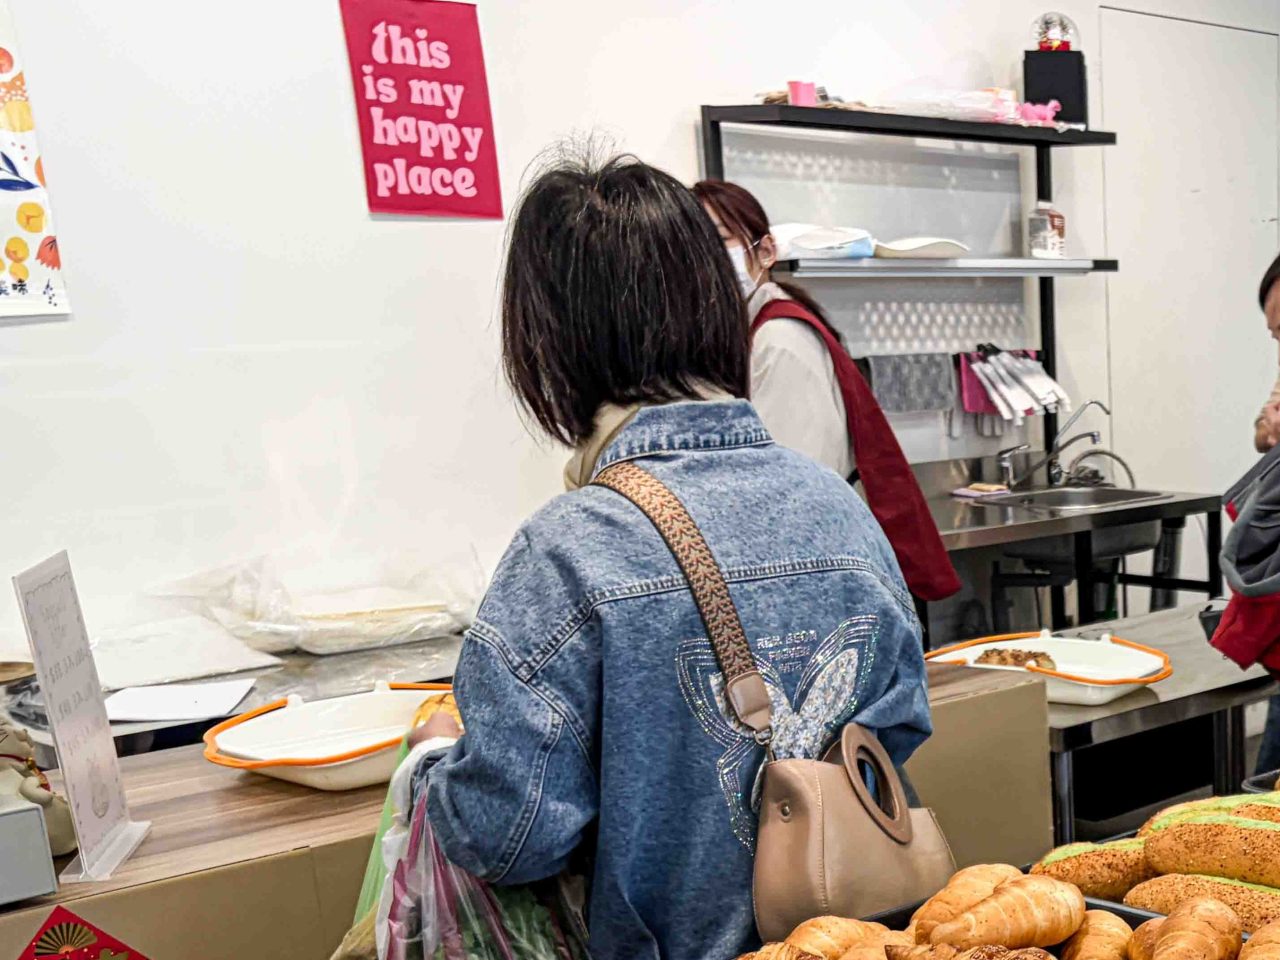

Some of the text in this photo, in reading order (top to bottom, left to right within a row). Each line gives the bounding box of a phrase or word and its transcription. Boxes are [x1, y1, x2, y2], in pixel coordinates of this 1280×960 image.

[371, 21, 450, 69] this
[361, 64, 465, 119] is my
[370, 106, 483, 162] happy
[373, 158, 477, 198] place
